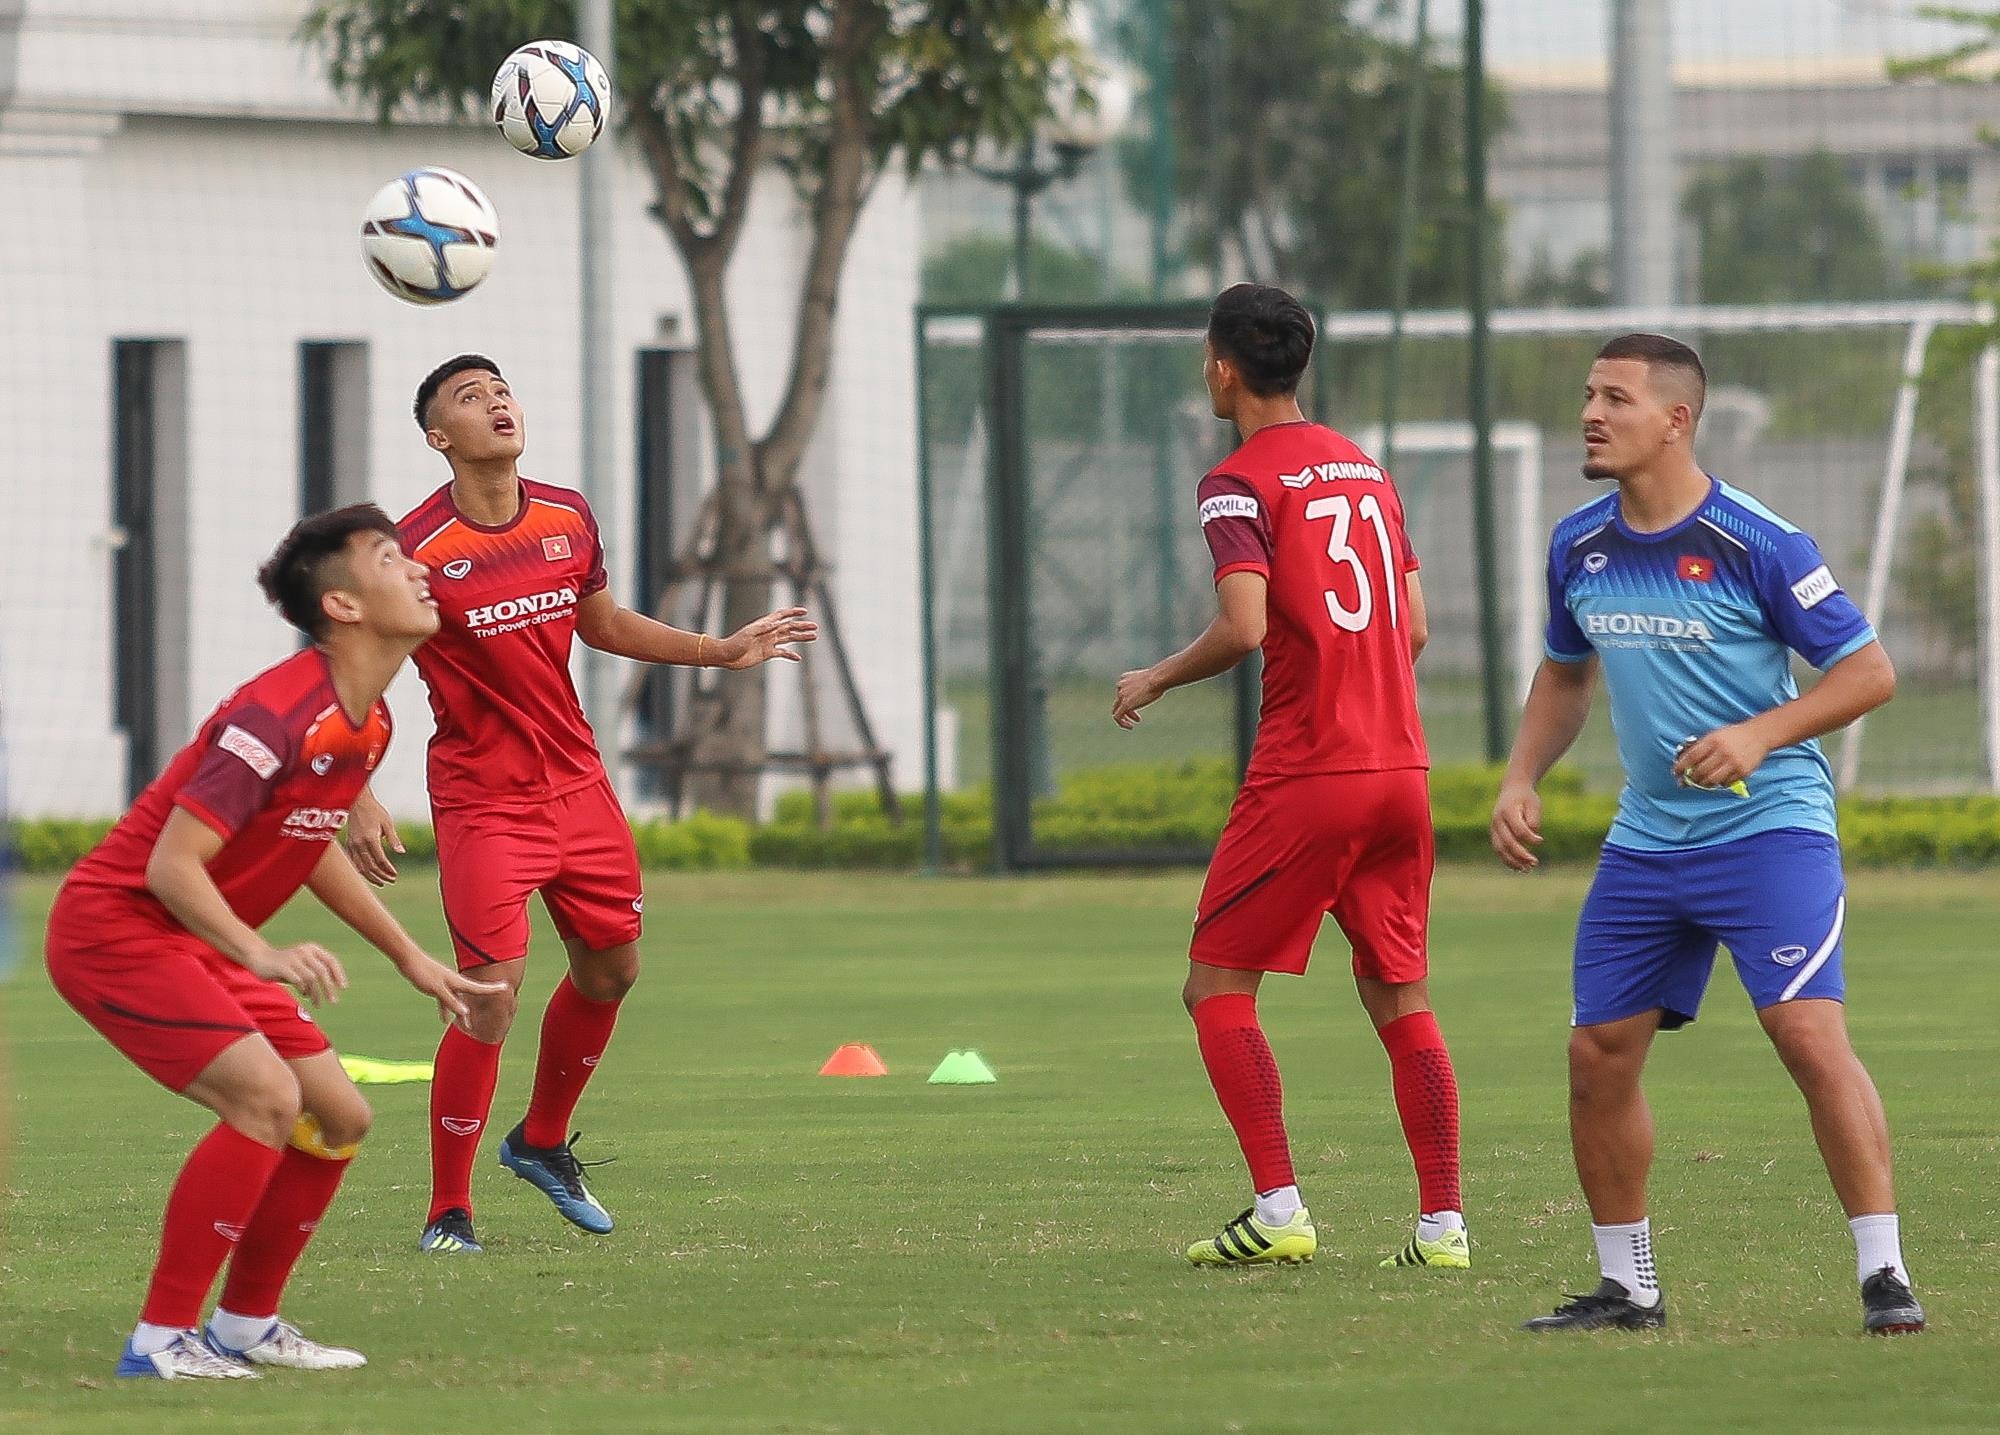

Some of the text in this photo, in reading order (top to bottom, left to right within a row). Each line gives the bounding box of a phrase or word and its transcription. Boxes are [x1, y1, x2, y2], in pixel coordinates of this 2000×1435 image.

[1313, 462, 1385, 484] YANMAR
[1305, 494, 1397, 632] 31
[465, 588, 577, 627] HONDA
[473, 607, 574, 638] The Power of Dreams
[1586, 613, 1715, 640] HONDA
